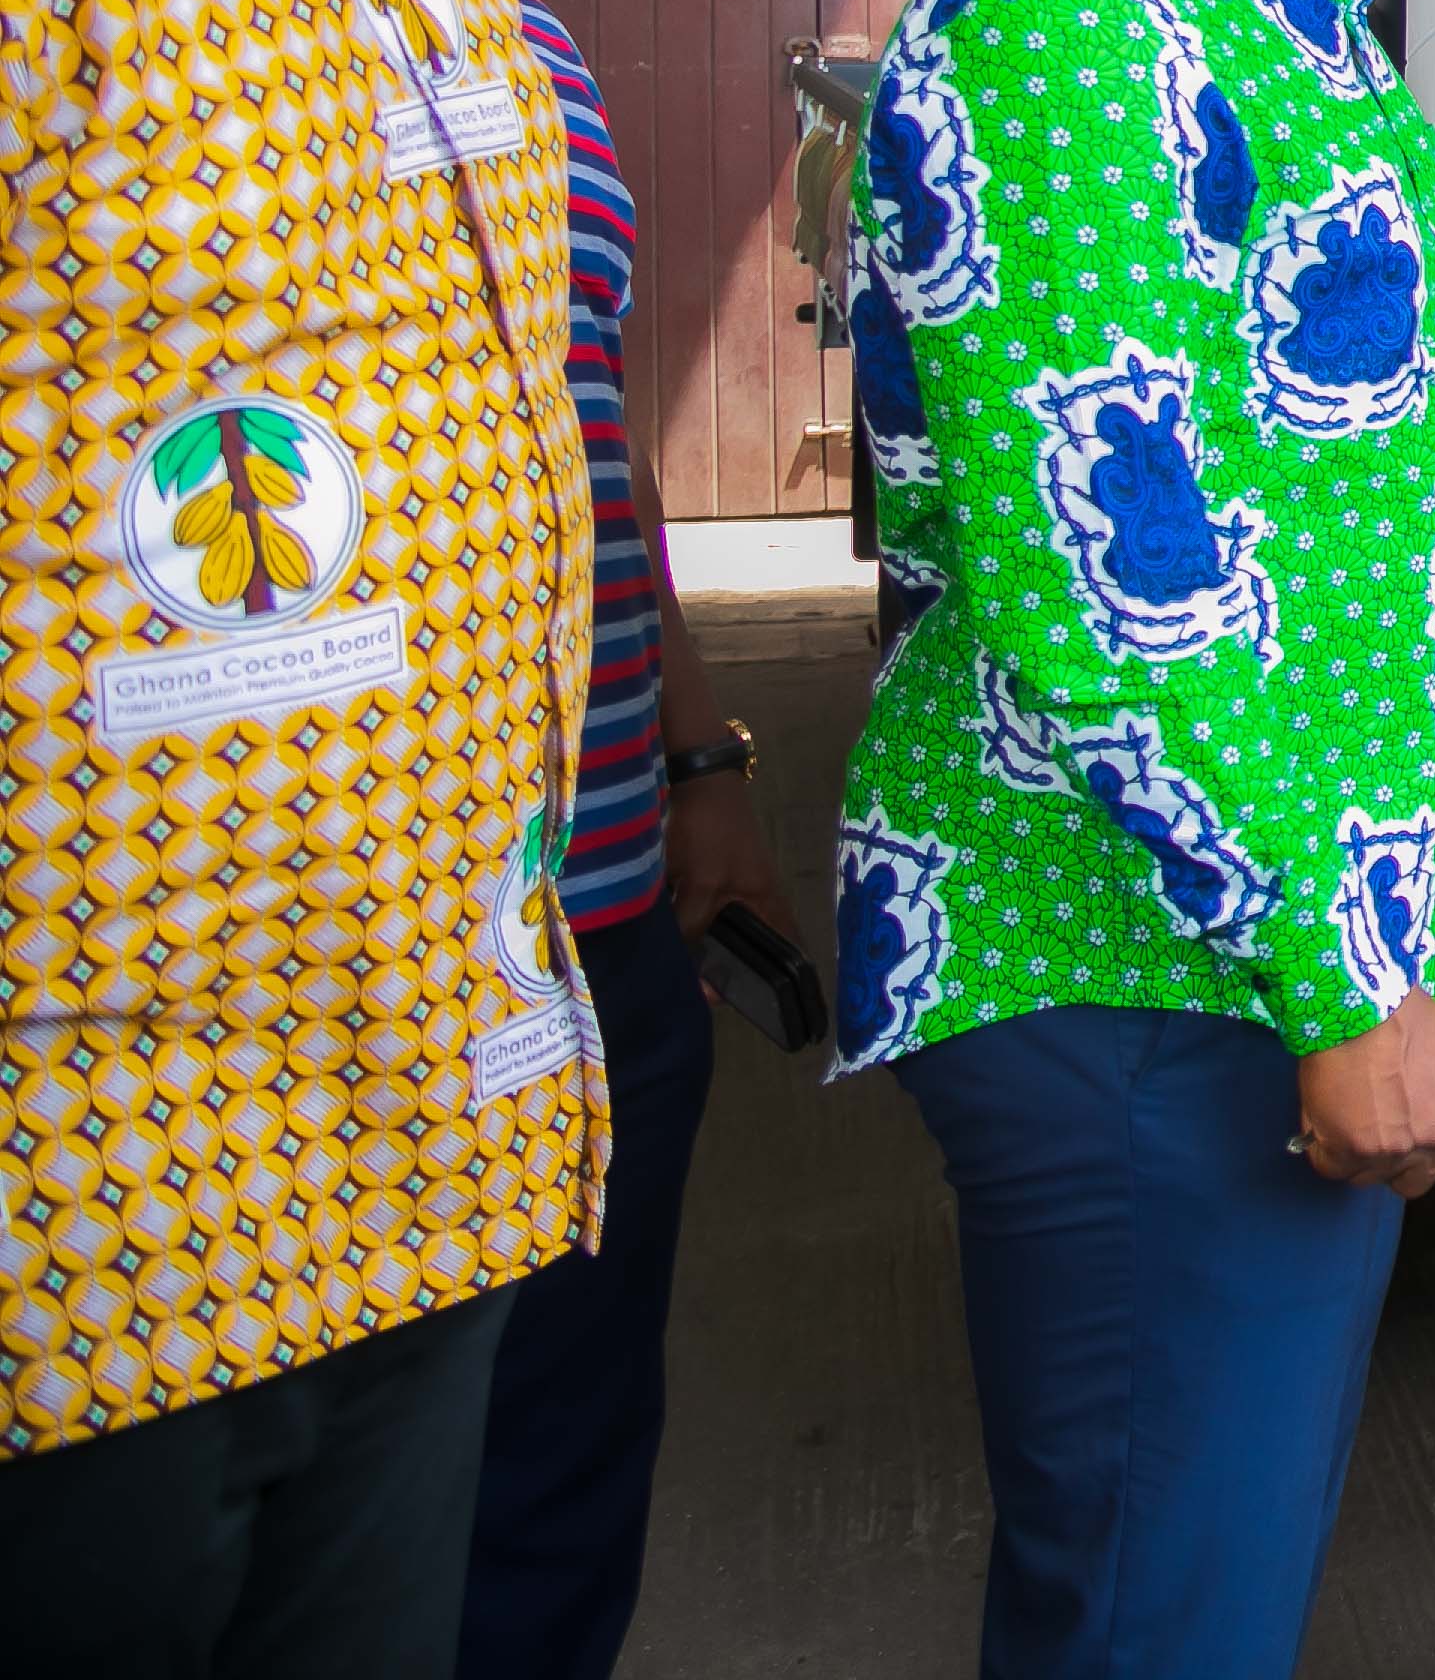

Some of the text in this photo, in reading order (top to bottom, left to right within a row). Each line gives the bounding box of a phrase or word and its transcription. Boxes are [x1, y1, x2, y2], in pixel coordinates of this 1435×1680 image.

[115, 624, 392, 699] Ghana Cocoa Board
[485, 1010, 579, 1067] Ghana Coc
